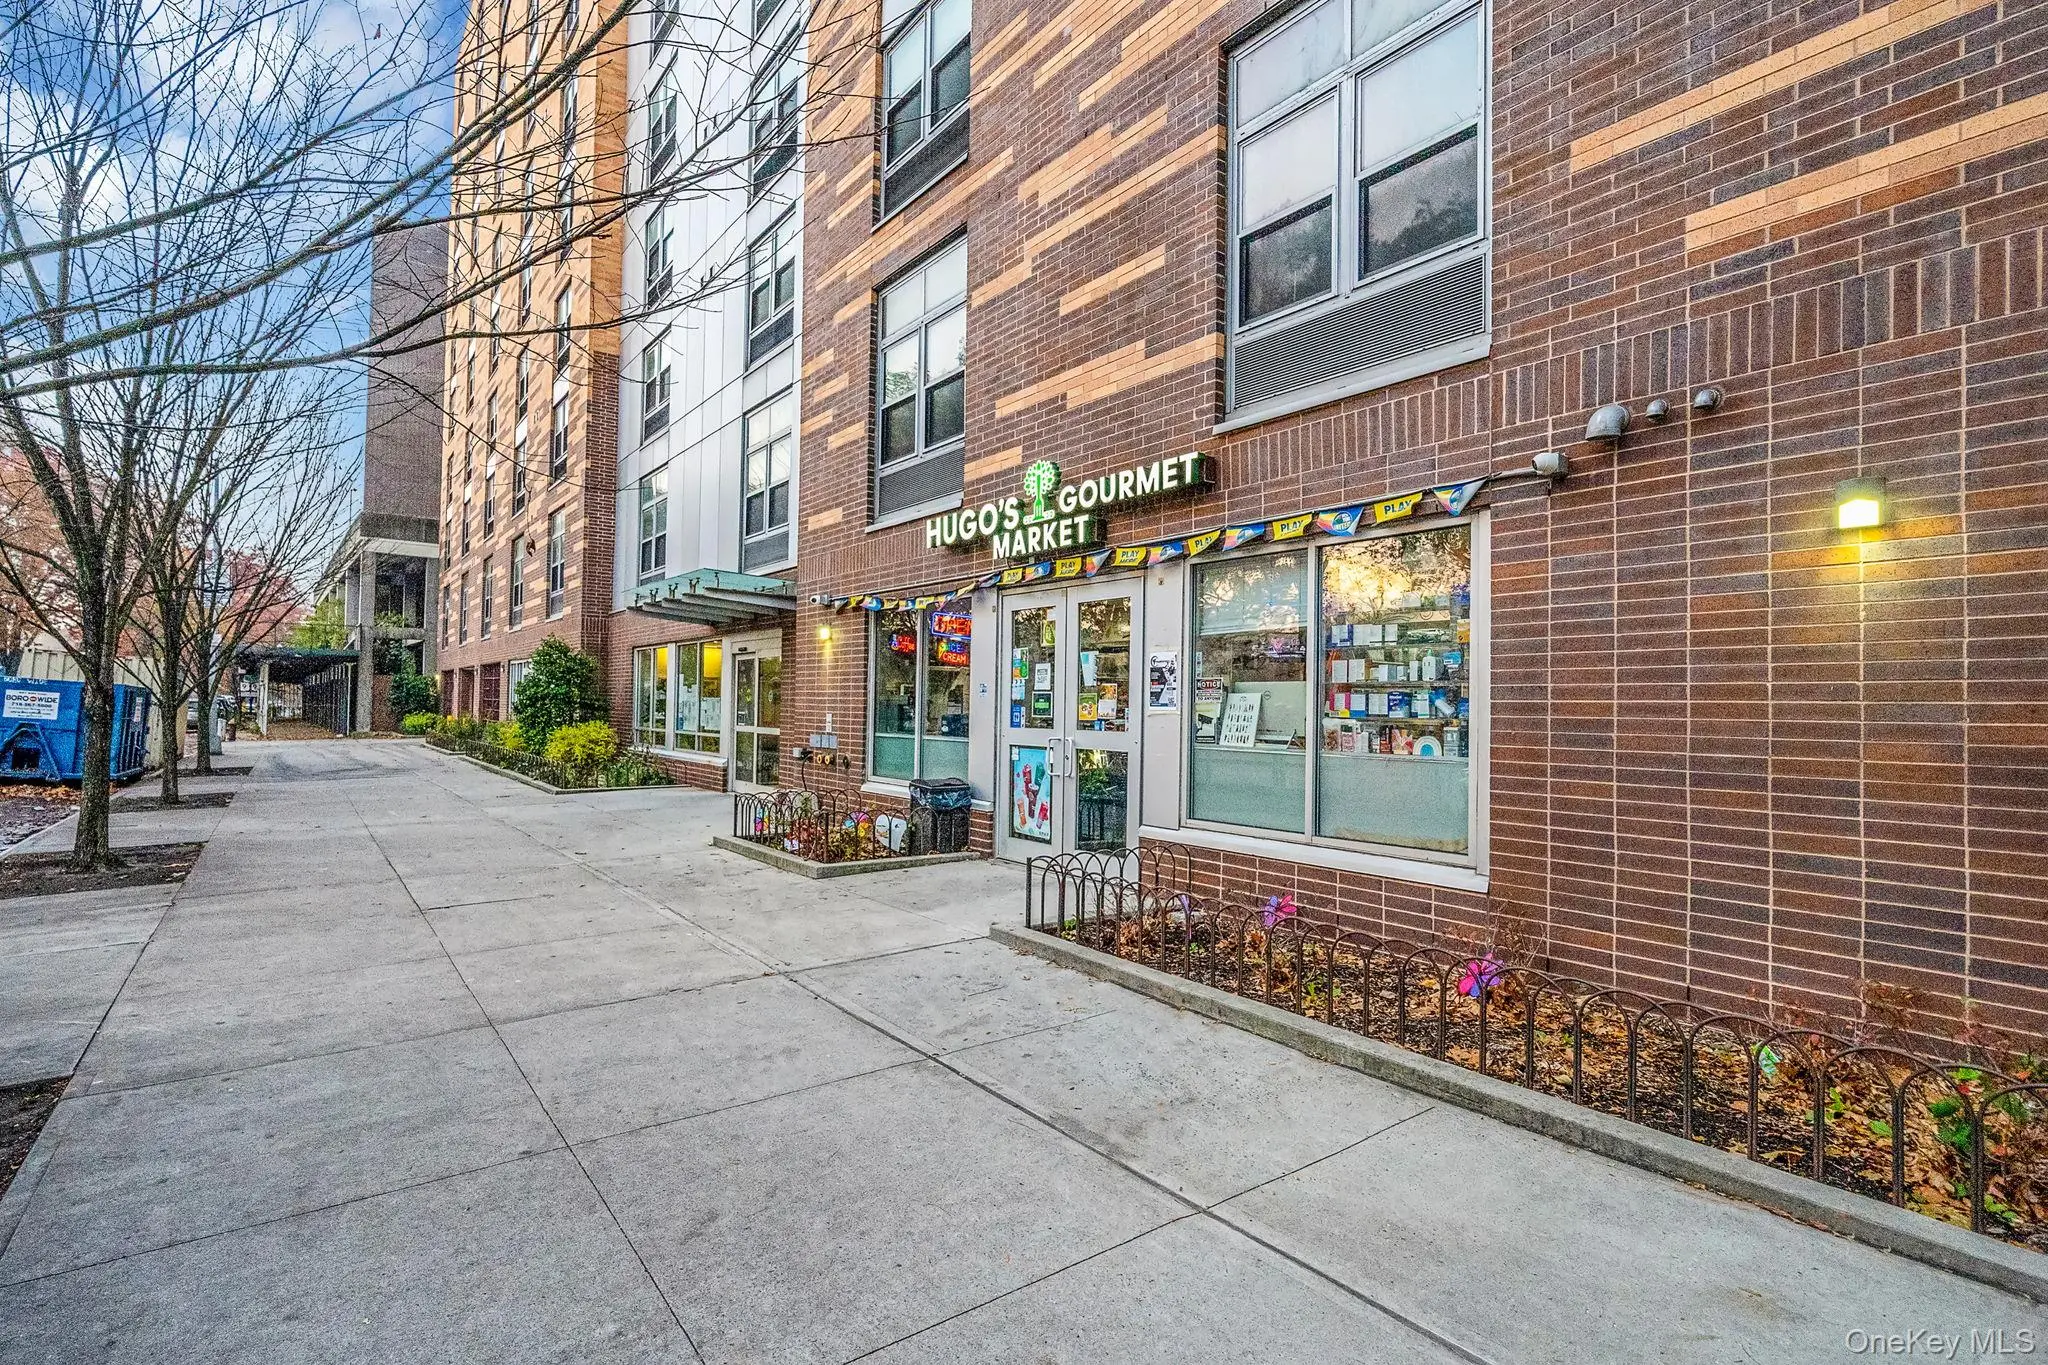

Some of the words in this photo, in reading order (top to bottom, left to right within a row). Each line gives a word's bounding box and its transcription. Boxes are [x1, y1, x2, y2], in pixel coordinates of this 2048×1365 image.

[926, 497, 1020, 549] HUGO'S
[1058, 451, 1200, 513] GOURMET
[1383, 499, 1412, 515] PLAY
[1280, 519, 1304, 533] PLAY
[992, 514, 1090, 560] MARKET
[1121, 550, 1140, 558] PLAY
[1060, 561, 1076, 569] PLAY
[942, 652, 967, 665] CREAM
[6, 694, 29, 702] BORO
